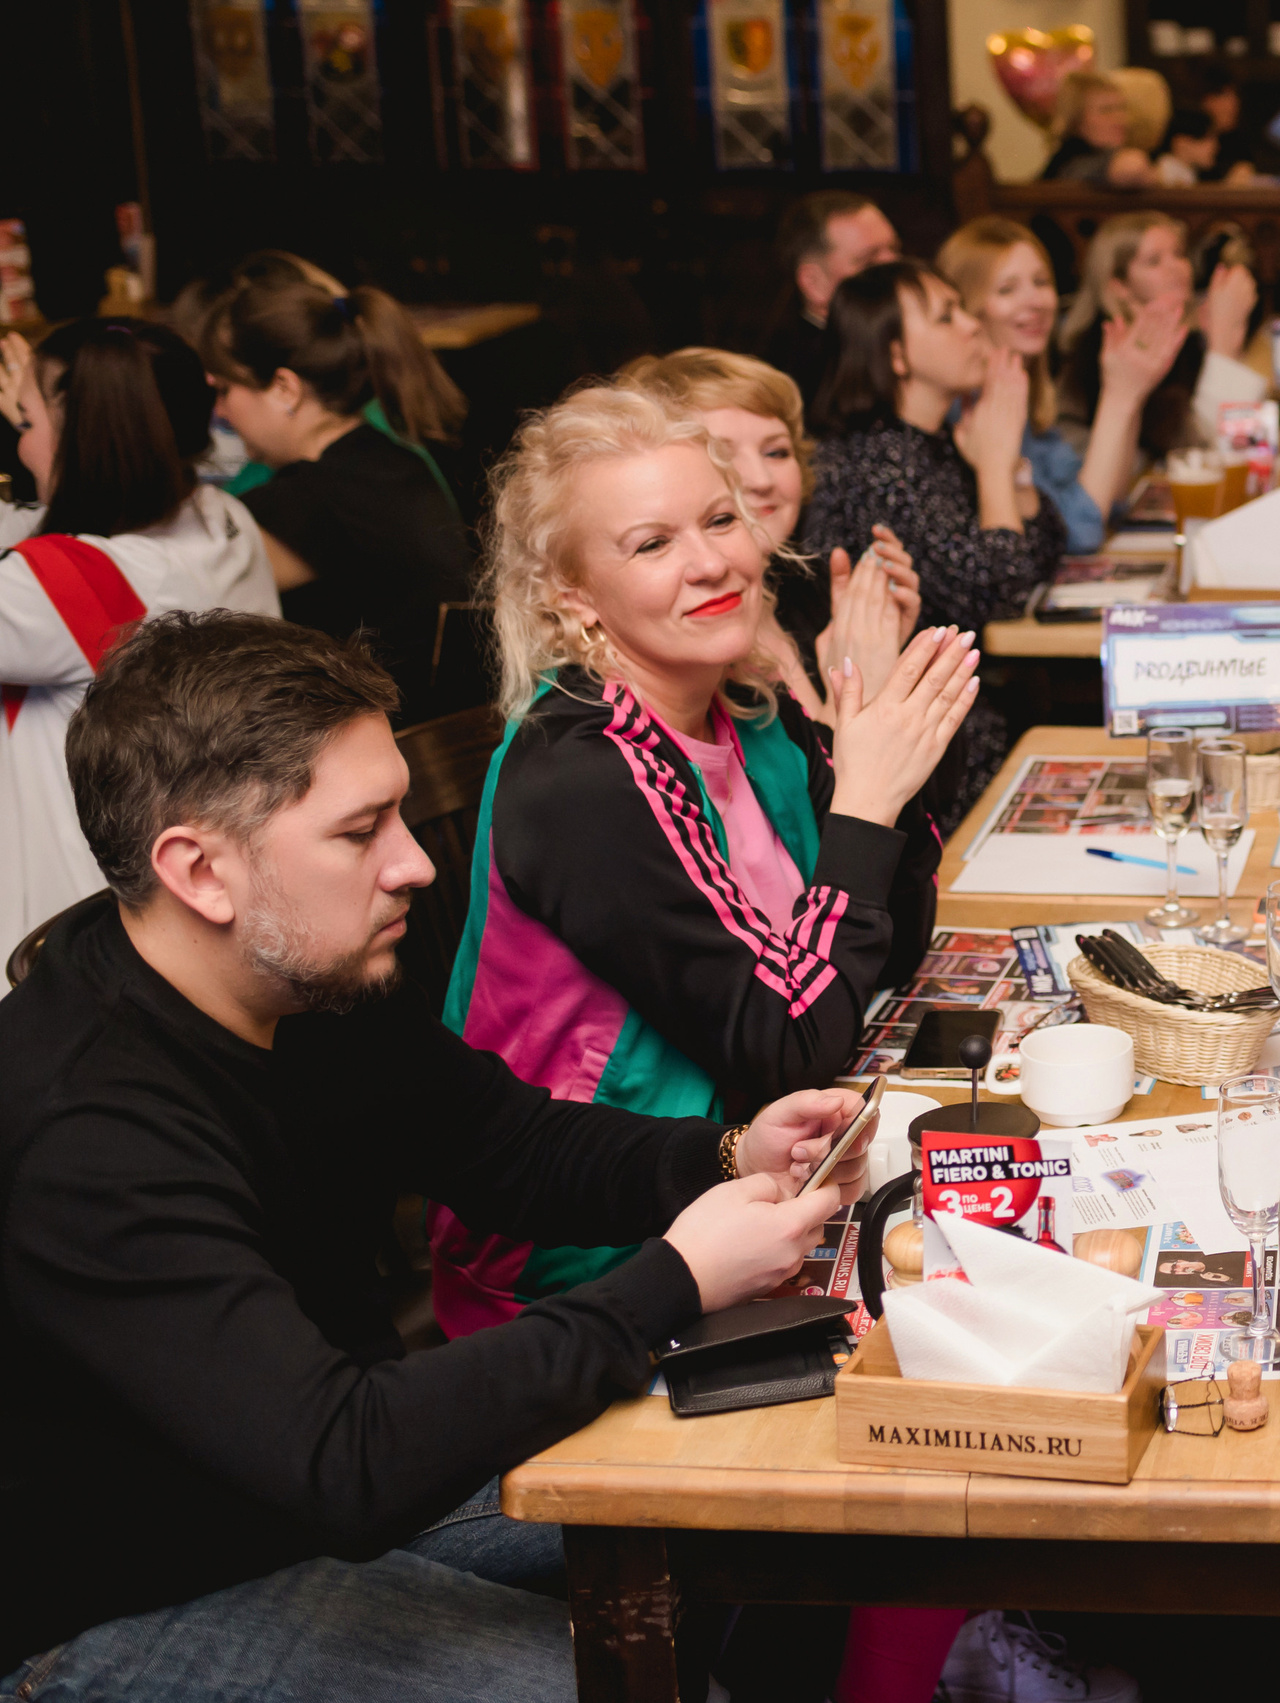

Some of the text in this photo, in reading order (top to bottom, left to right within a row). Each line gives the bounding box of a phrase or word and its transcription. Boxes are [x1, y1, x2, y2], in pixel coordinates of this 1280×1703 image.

[931, 1146, 1009, 1166] MARTINI
[932, 1159, 1069, 1184] FIERO & TONIC
[938, 1189, 964, 1218] 3
[962, 1194, 978, 1204] ПО
[964, 1202, 992, 1214] ЦЕНЕ
[990, 1186, 1015, 1218] 2
[834, 1229, 859, 1292] MAXIMILIANS.RU
[1193, 1333, 1214, 1355] СВОИХ
[868, 1424, 1083, 1457] MAXIMILIANS.RU
